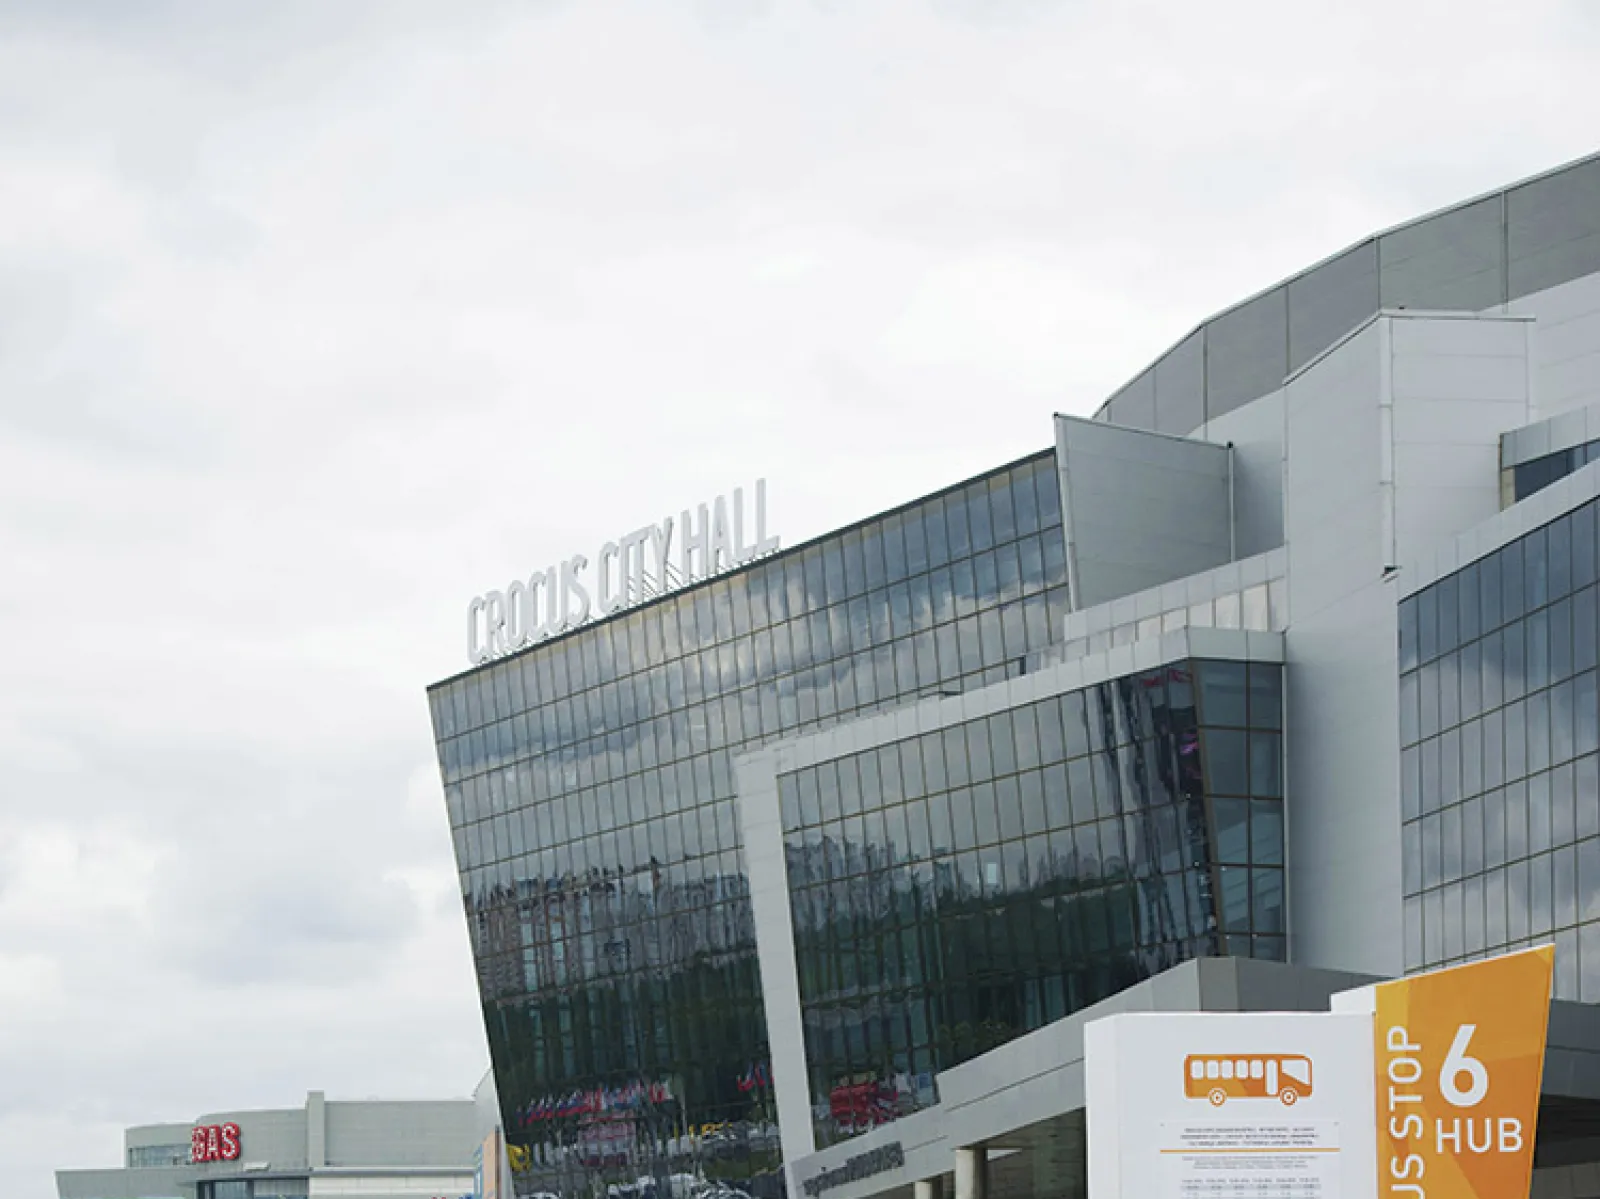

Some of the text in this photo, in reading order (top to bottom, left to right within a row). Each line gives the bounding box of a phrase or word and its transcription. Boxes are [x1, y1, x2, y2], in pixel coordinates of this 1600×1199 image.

[466, 477, 781, 664] CROCUS CITY HALL
[1386, 1025, 1424, 1140] STOP
[1439, 1023, 1490, 1107] 6
[1435, 1117, 1524, 1154] HUB
